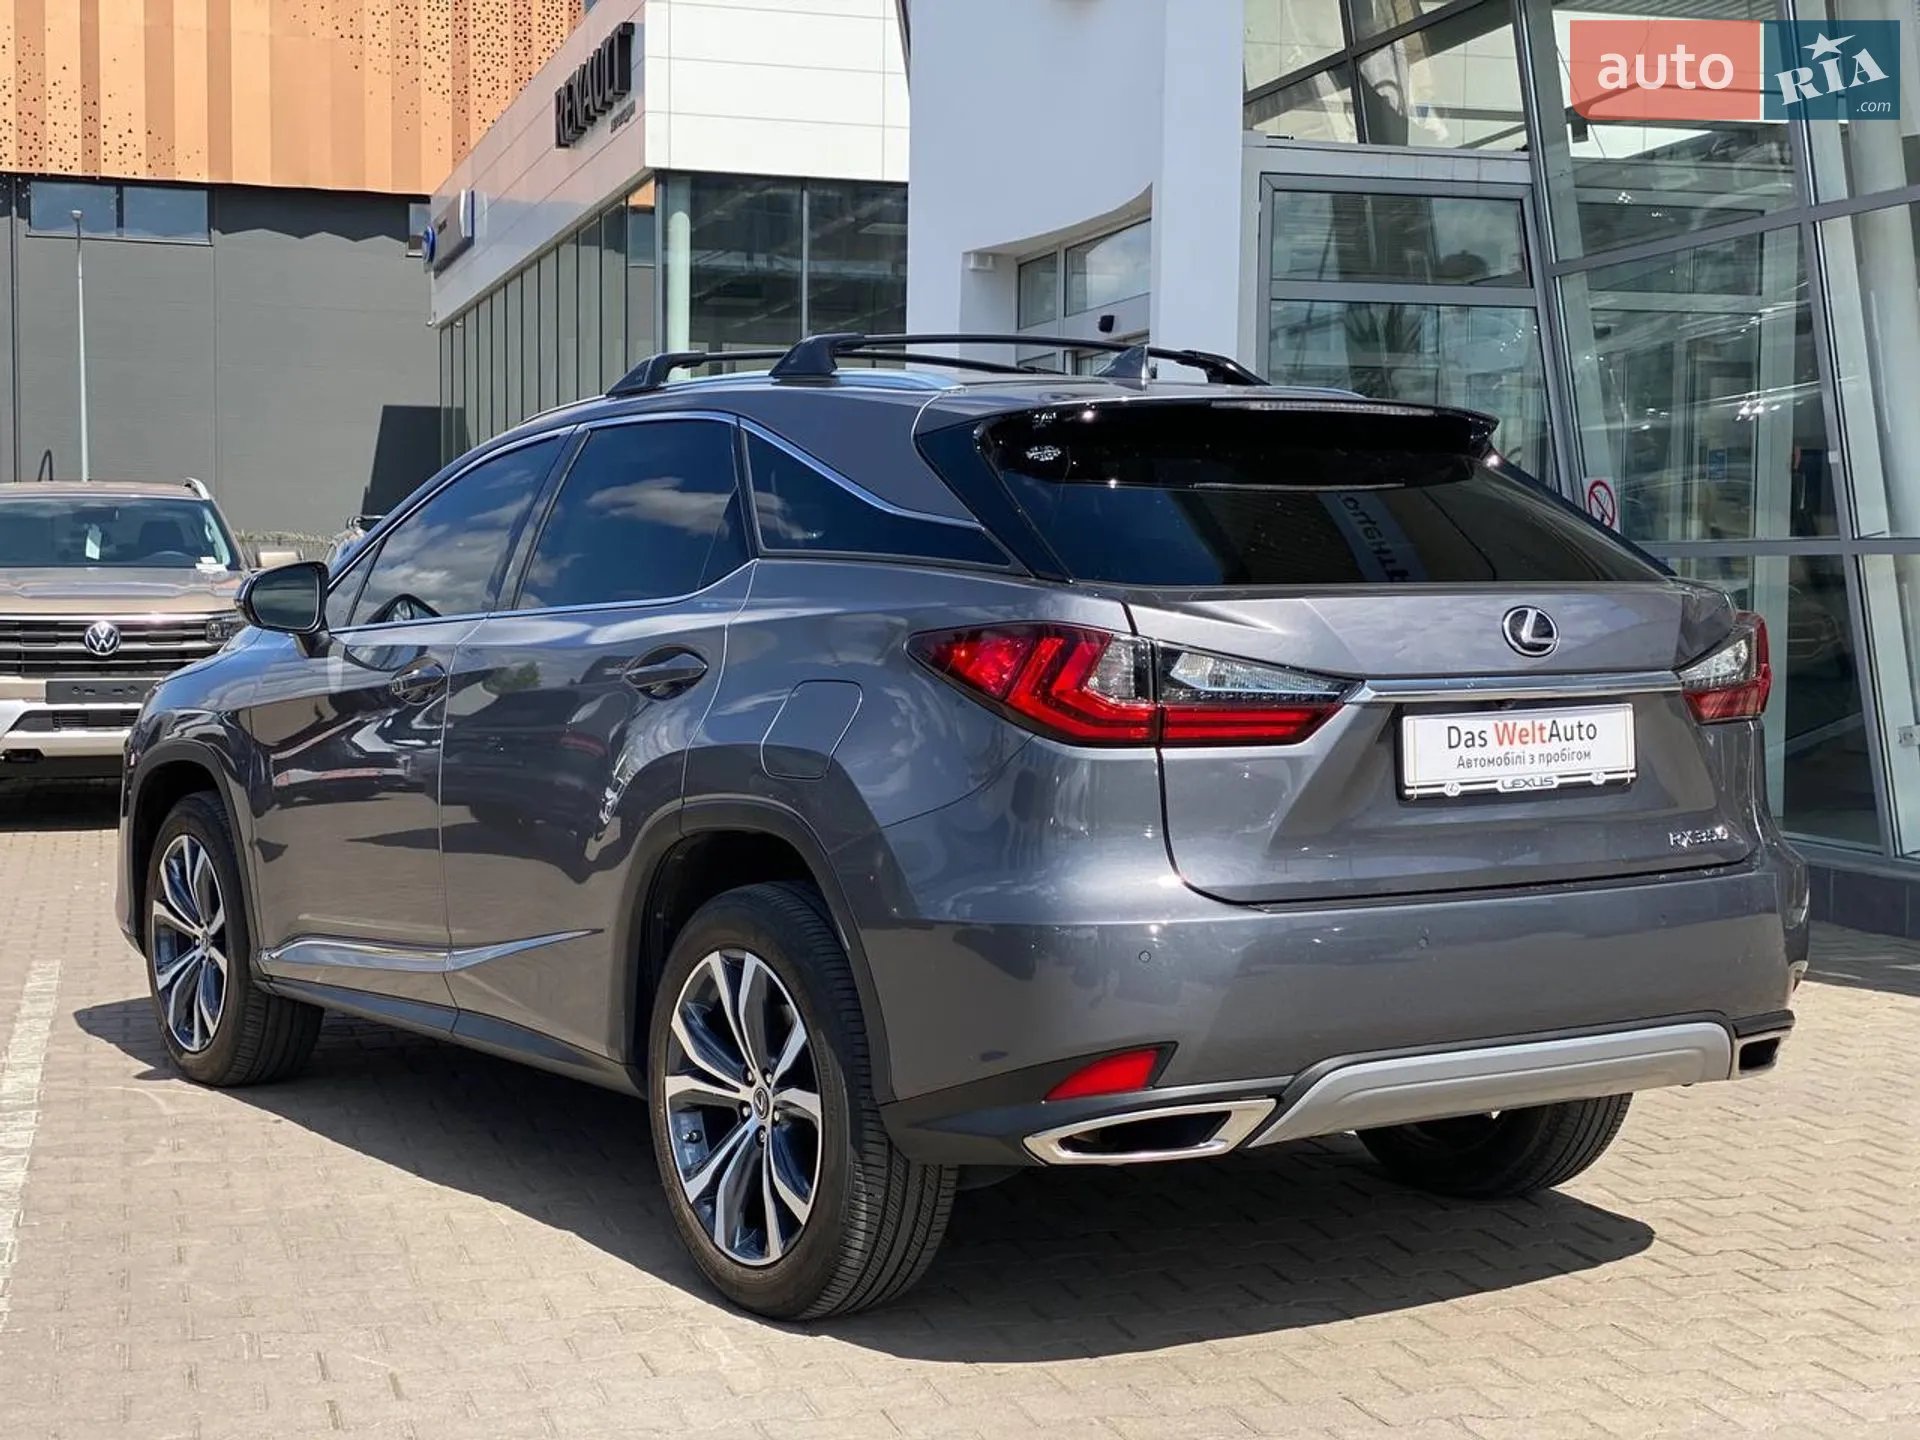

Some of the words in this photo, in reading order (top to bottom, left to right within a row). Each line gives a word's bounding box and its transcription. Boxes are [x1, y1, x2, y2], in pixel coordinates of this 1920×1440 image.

[555, 21, 635, 149] RENAULT
[1446, 724, 1488, 750] Das
[1493, 719, 1598, 747] WeltAuto
[1456, 751, 1526, 769] Автомобілі
[1529, 753, 1536, 765] з
[1538, 748, 1592, 767] пробігом
[1499, 776, 1555, 790] LEXUS
